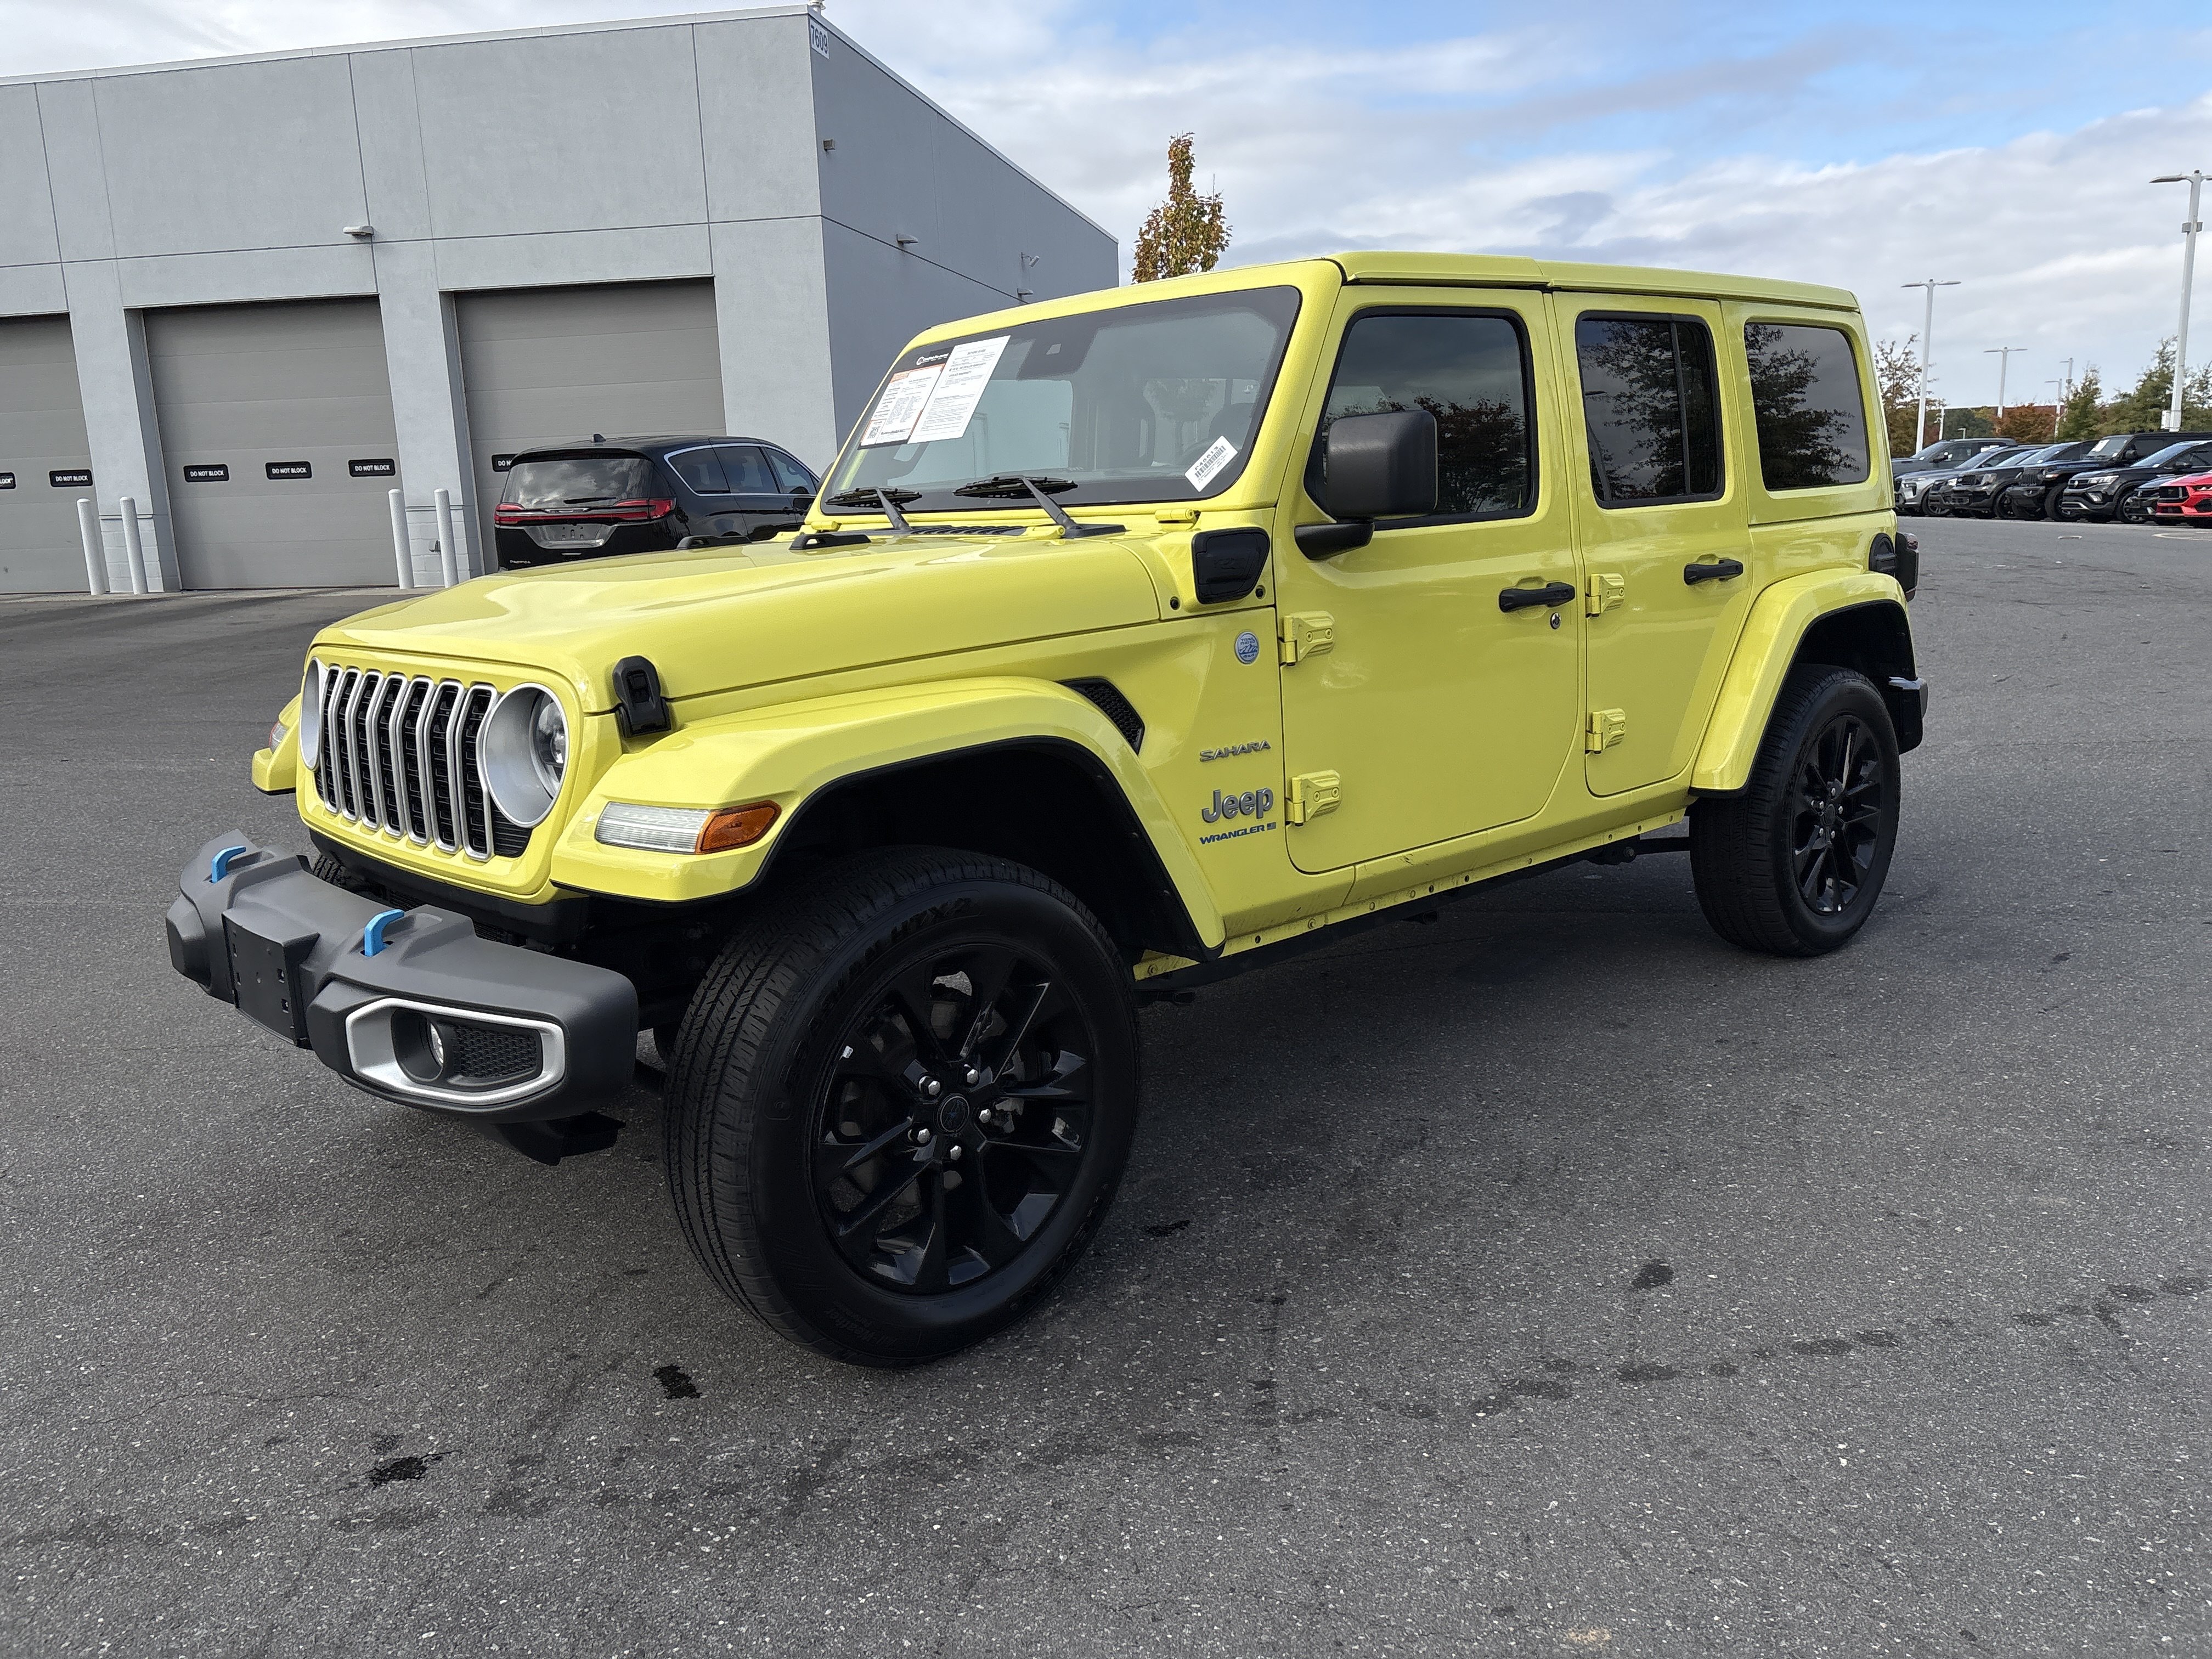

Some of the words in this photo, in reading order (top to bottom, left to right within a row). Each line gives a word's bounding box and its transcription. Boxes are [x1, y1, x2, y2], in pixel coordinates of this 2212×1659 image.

[811, 25, 828, 54] 7609
[1200, 740, 1271, 762] SAHARA
[1201, 788, 1274, 823] Jeep
[1199, 825, 1265, 845] WRANGLER
